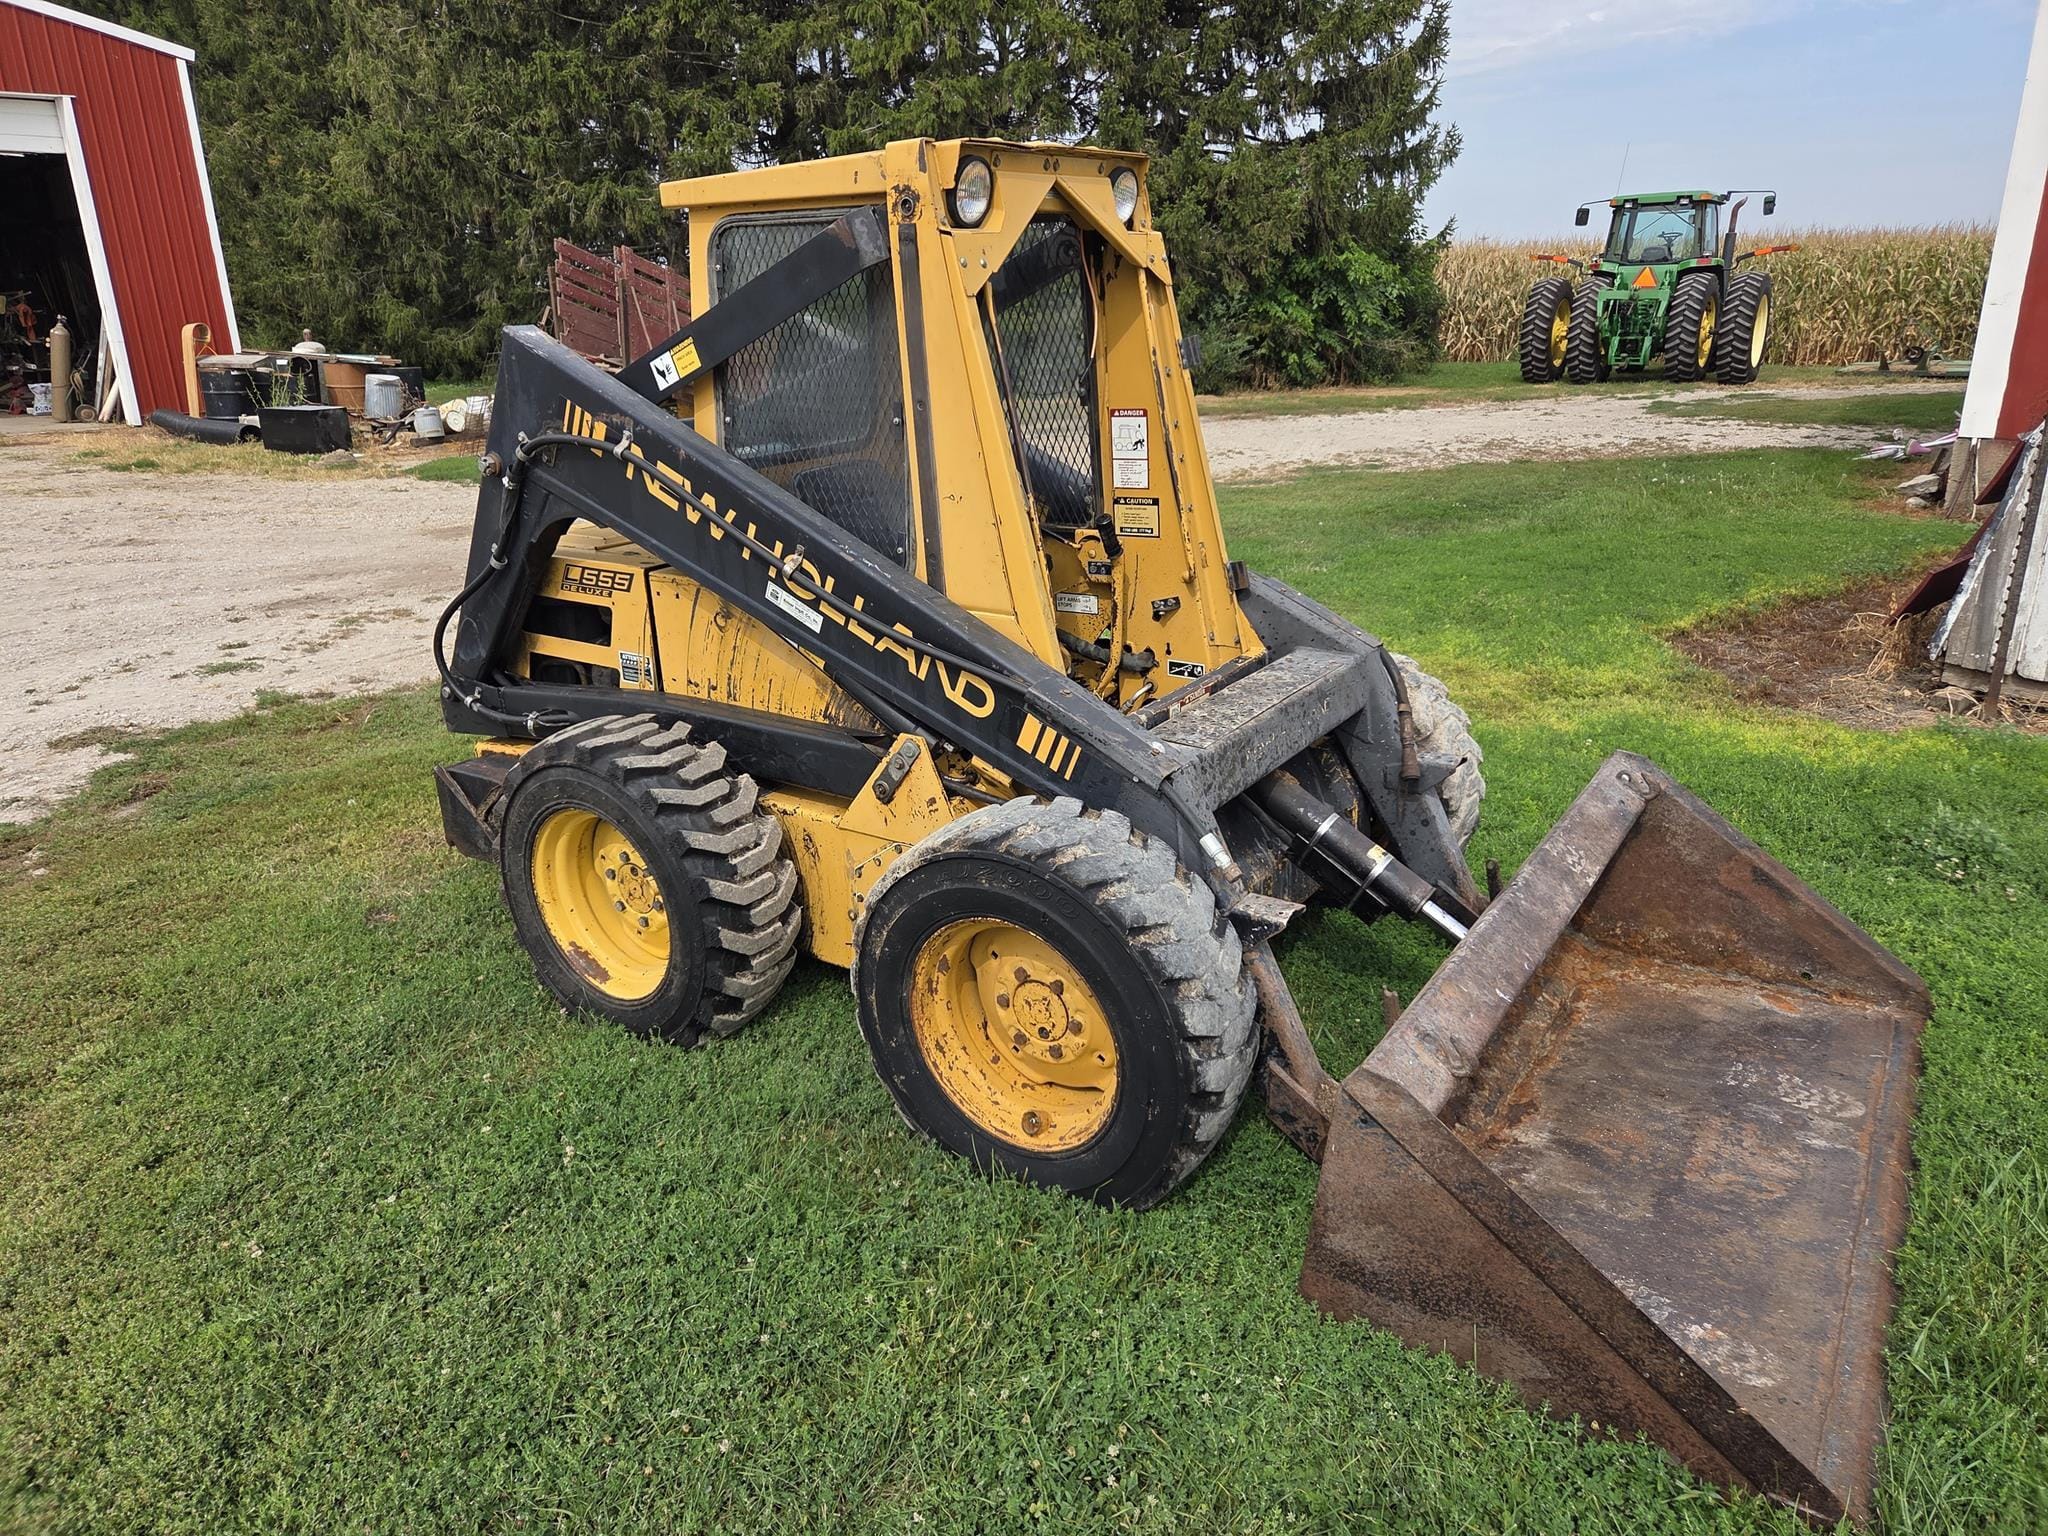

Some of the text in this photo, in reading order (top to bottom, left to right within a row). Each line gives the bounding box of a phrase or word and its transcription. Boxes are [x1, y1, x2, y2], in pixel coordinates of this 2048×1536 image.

[562, 584, 610, 597] DELUXE
[564, 565, 632, 593] L555
[626, 442, 996, 719] NEW HOLLAND
